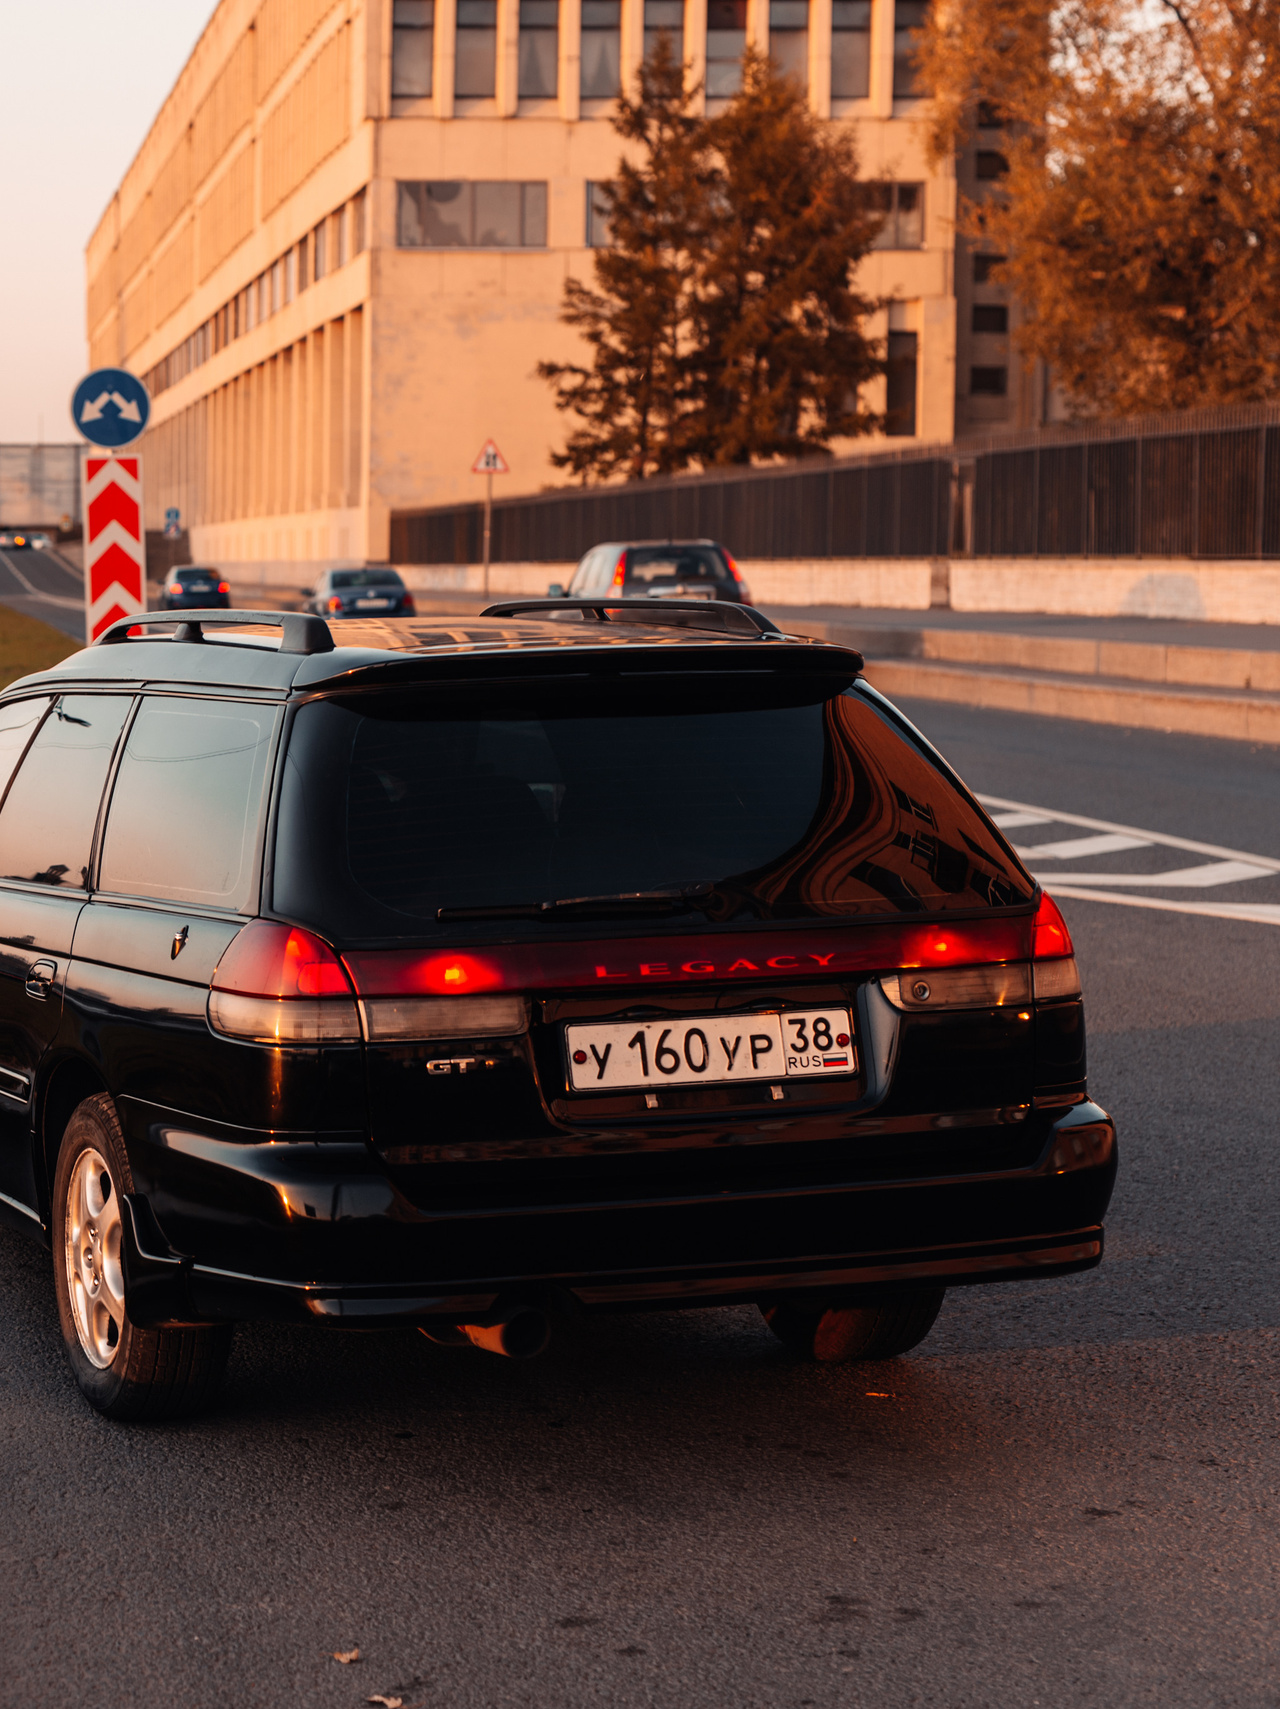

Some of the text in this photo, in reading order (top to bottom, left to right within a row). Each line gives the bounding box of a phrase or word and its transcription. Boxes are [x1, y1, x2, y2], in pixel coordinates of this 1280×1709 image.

[595, 953, 836, 978] LEGACY
[787, 1017, 834, 1053] 38
[426, 1058, 476, 1075] GT
[788, 1055, 822, 1069] RUS
